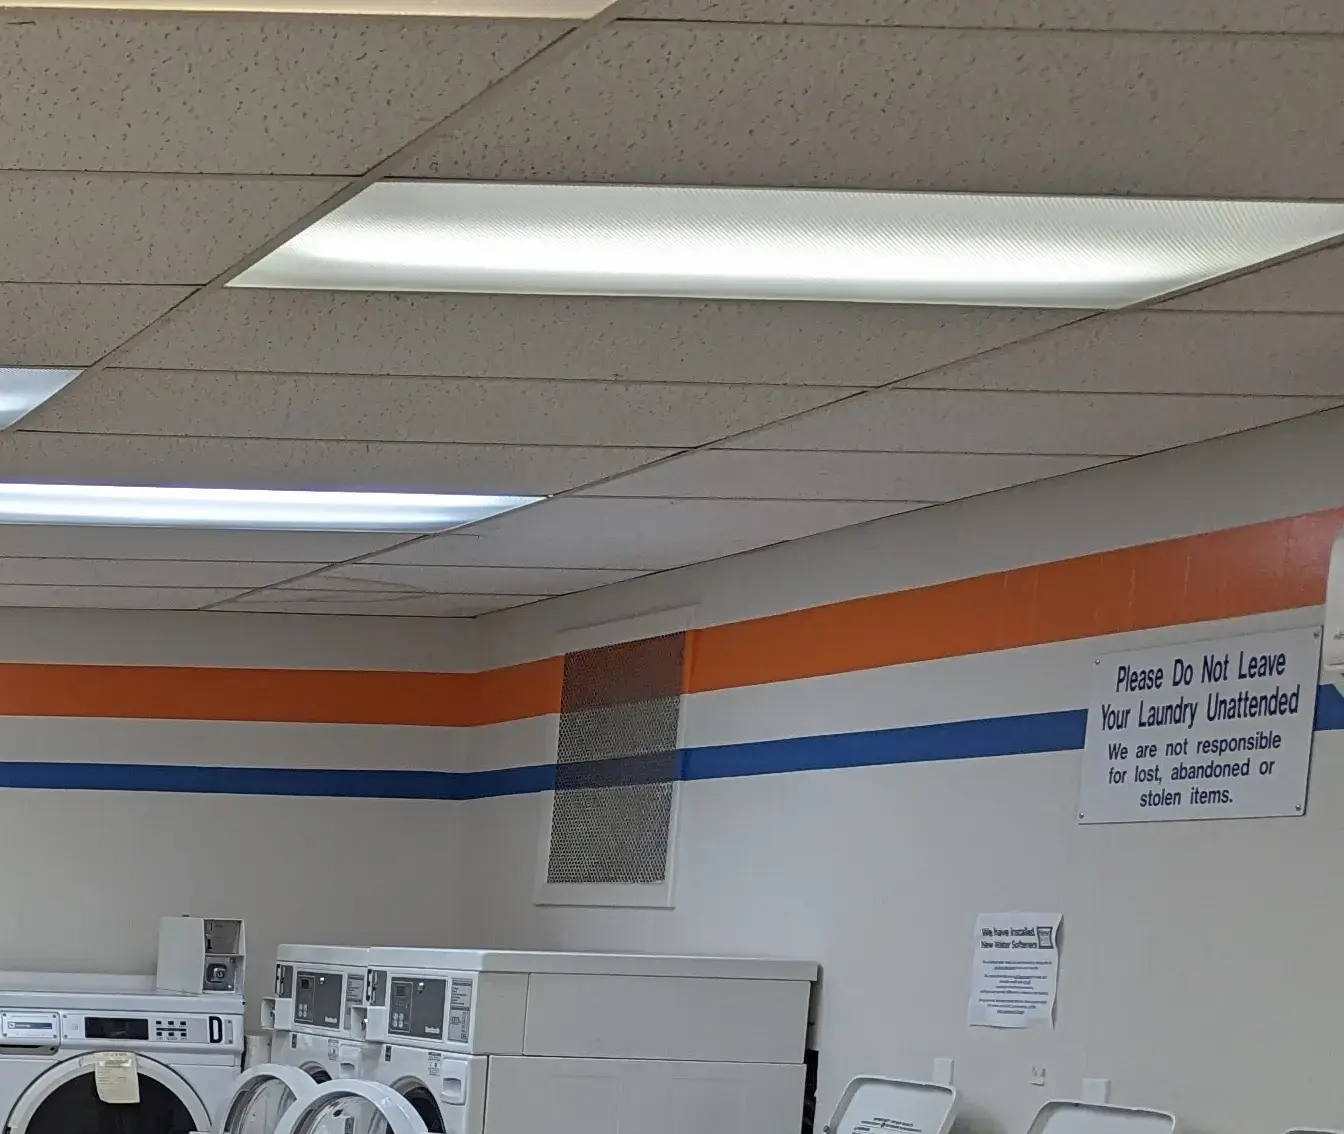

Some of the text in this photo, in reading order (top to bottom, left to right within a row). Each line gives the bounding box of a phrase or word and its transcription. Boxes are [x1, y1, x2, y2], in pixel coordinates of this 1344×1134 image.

[1116, 650, 1286, 692] Please Do Not Leave
[1101, 684, 1301, 730] Your Laundry Unattended
[1108, 730, 1282, 760] We are not responsible
[1109, 758, 1275, 785] for lost, abandoned or
[1140, 787, 1233, 807] stolen items.
[209, 1016, 223, 1043] D
